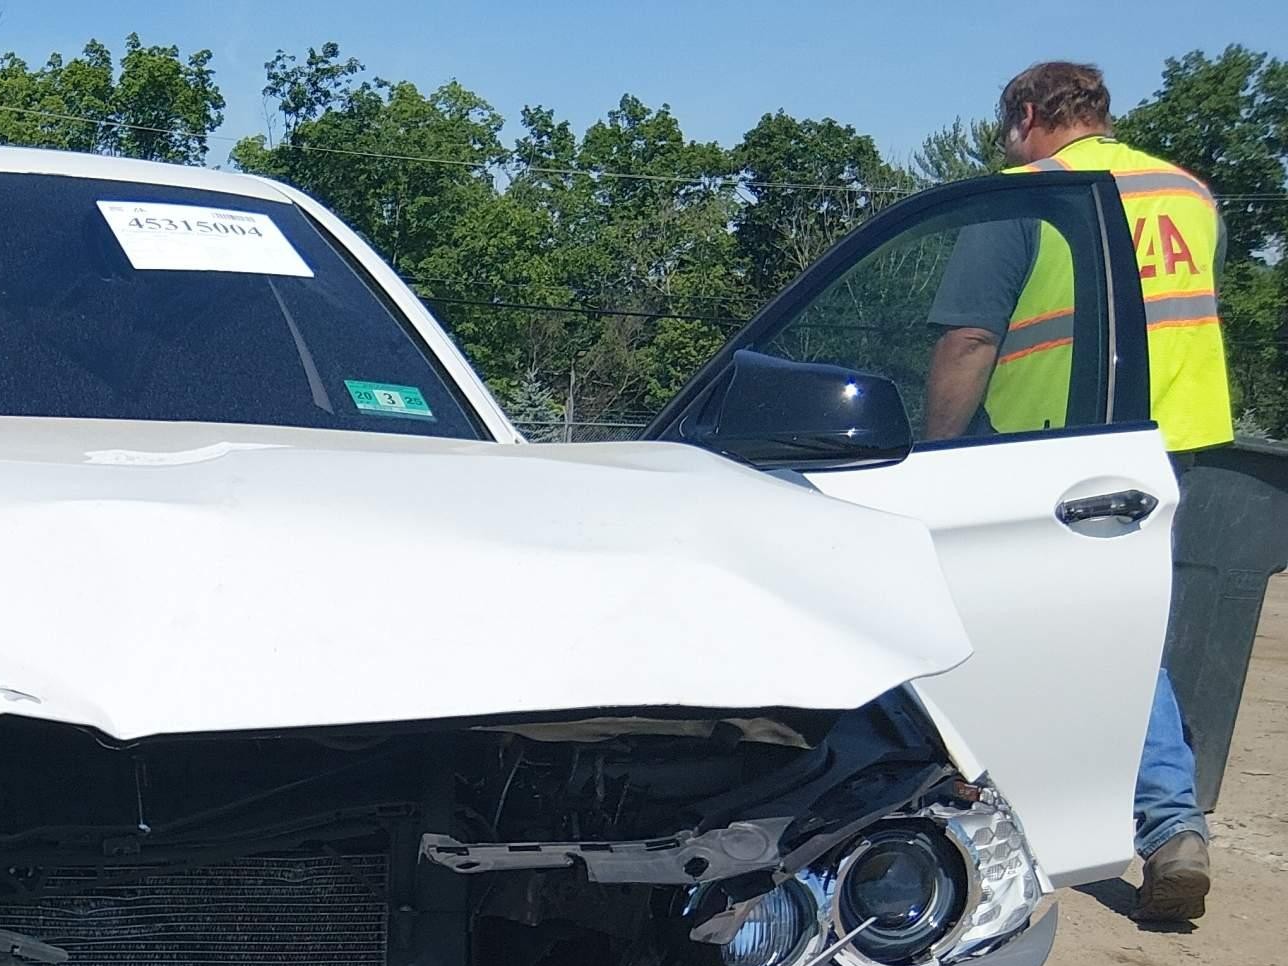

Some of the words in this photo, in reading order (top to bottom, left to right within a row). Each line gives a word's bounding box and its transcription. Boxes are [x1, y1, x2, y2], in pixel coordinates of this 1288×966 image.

[128, 216, 263, 238] 45315004
[355, 391, 373, 401] 20
[383, 393, 397, 405] 3
